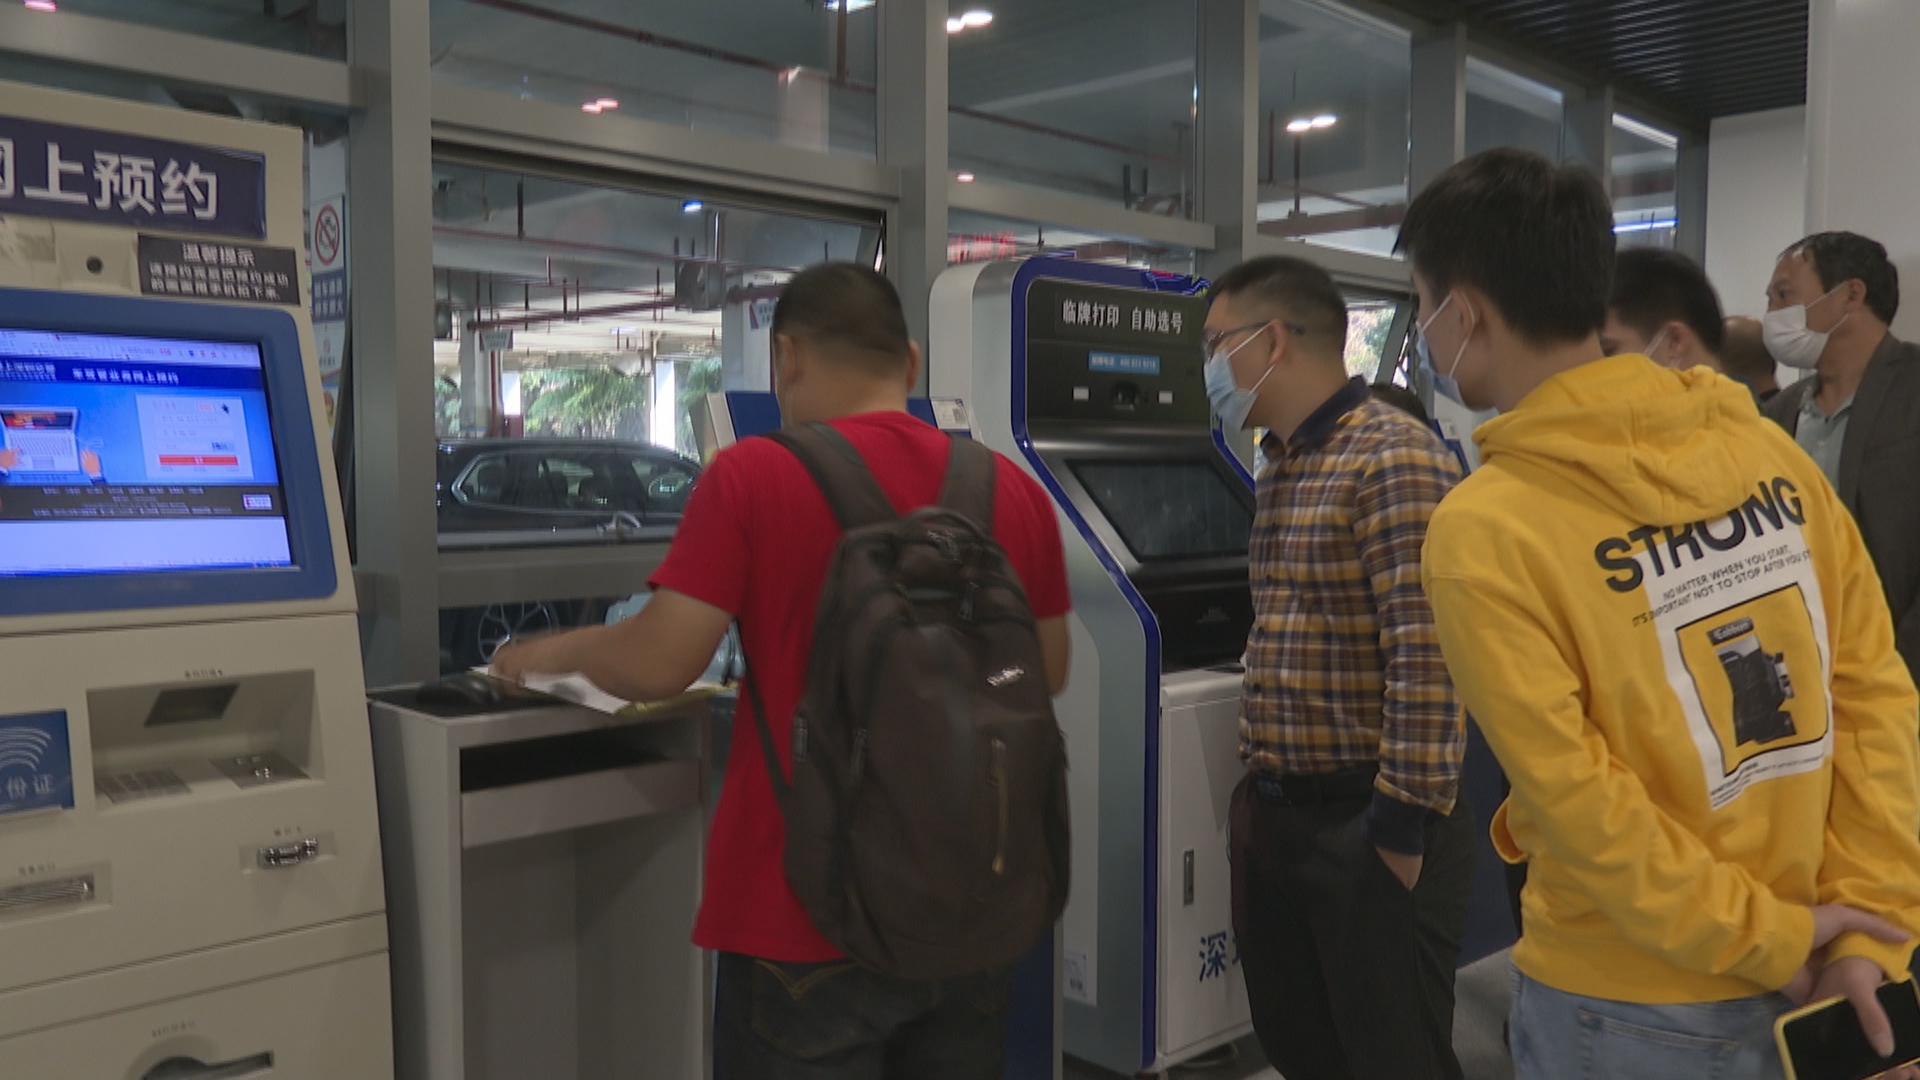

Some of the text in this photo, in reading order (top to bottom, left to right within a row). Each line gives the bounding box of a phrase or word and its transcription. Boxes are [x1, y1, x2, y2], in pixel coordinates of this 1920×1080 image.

[0, 139, 218, 219] 上预约
[182, 243, 256, 267] 温馨提示
[1062, 298, 1183, 335] 临牌打印 自助选号
[1594, 476, 1806, 593] STRONG
[1649, 593, 1691, 620] IMPORTANT
[1693, 584, 1715, 599] NOT
[1716, 578, 1734, 591] TO
[1735, 566, 1761, 583] STOP
[1763, 558, 1786, 574] AFTER
[1786, 552, 1802, 564] YOU
[1663, 588, 1676, 600] NO
[1676, 574, 1709, 593] MATTER
[1709, 562, 1744, 580] WHEN
[1744, 552, 1767, 566] YOU
[0, 774, 55, 801] 份证
